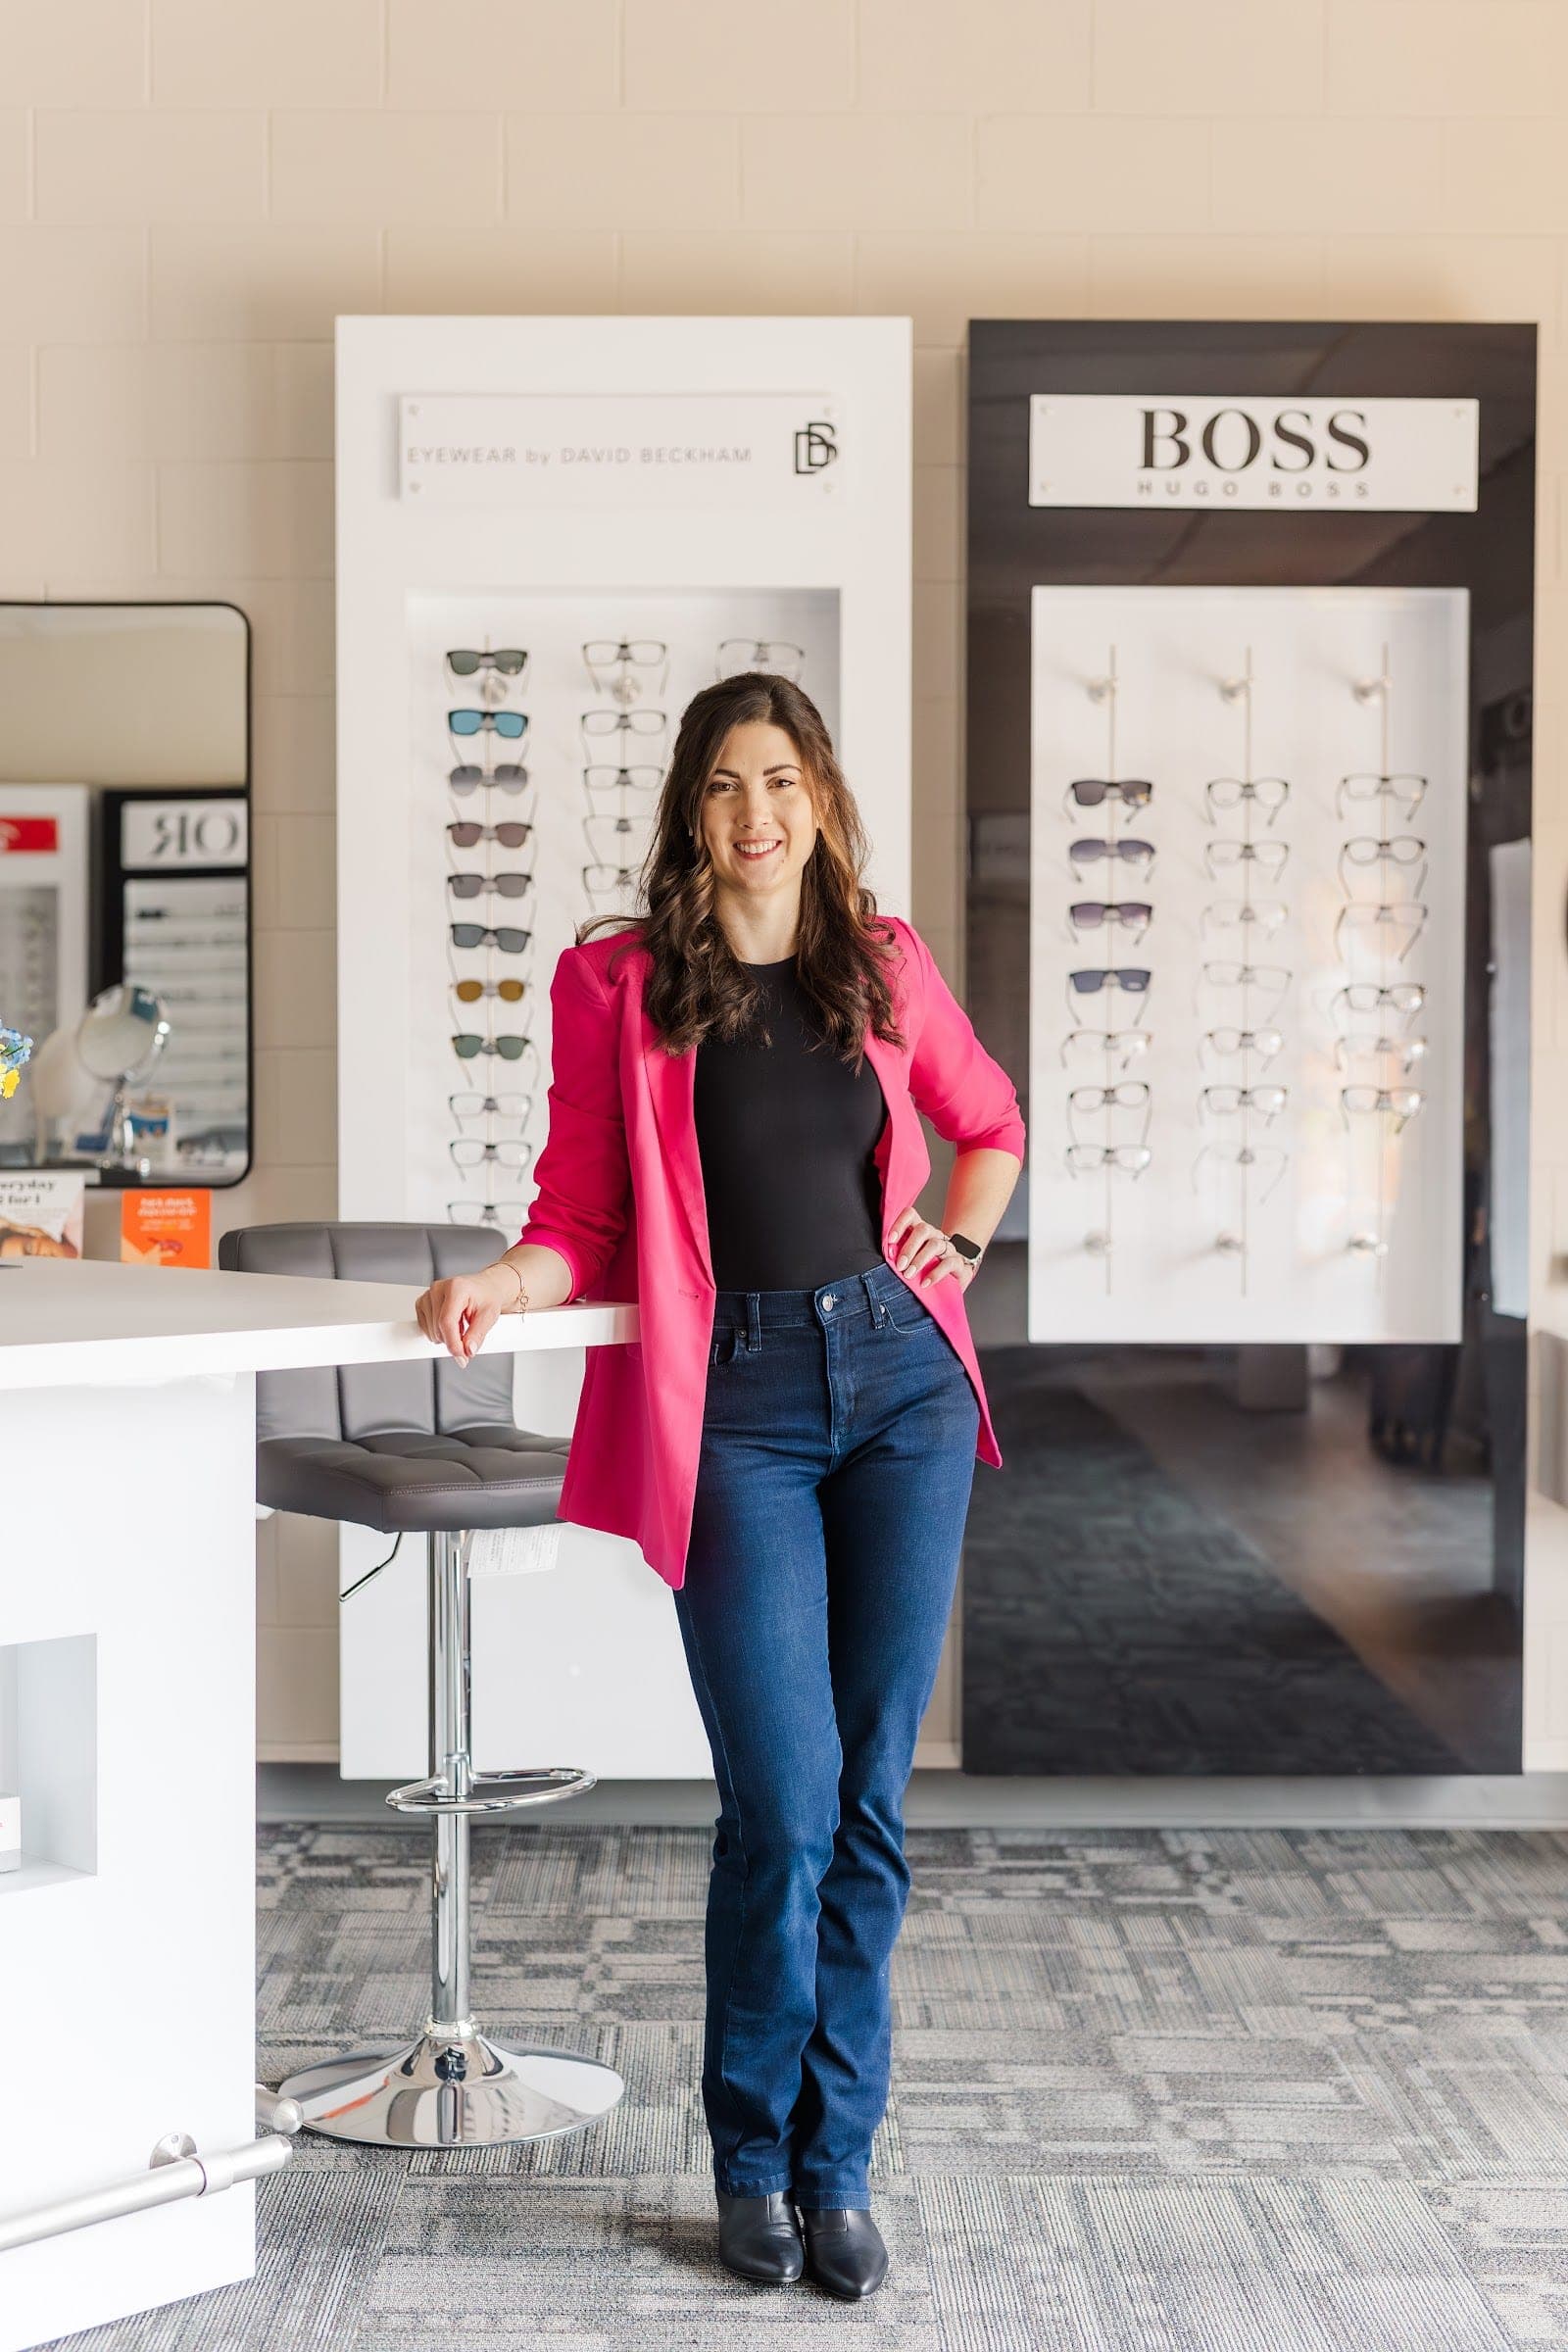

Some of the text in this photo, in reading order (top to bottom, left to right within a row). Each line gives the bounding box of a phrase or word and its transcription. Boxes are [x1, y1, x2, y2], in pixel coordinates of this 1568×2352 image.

[1139, 408, 1370, 472] BOSS
[407, 446, 752, 466] EYEWEAR by DAVID BECKHAM
[1137, 479, 1370, 499] HUGO BOSS
